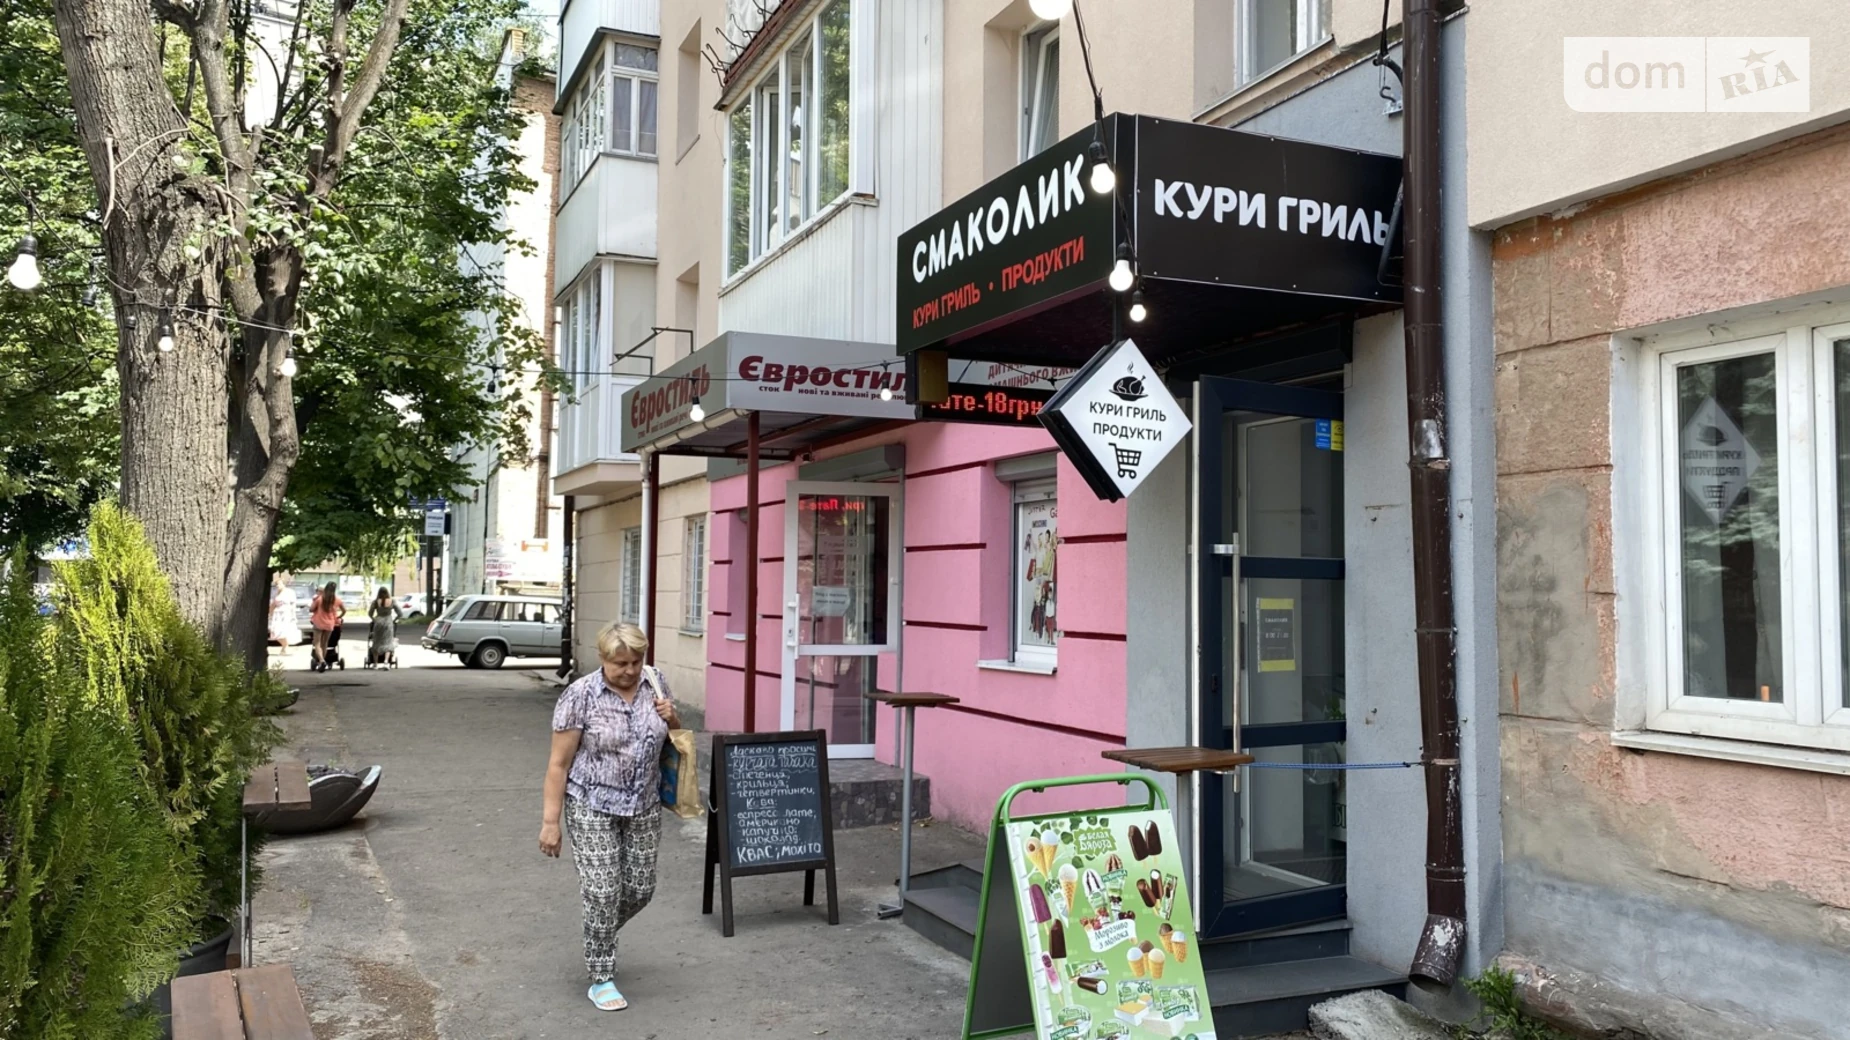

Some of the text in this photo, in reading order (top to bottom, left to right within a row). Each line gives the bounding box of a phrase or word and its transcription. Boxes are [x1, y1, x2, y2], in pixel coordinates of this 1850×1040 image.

[912, 154, 1085, 283] СМАКОЛИК
[1155, 178, 1390, 246] КУРИ ГРИЛЬ
[912, 236, 1084, 329] КУРИ ГРИЛЬ ПРОДУКТИ
[739, 355, 906, 392] Євростил
[798, 387, 818, 395] нові
[831, 391, 869, 399] вживані
[1090, 401, 1167, 422] КУРИ ГРИЛЬ
[1093, 422, 1162, 442] ПРОДУКТИ
